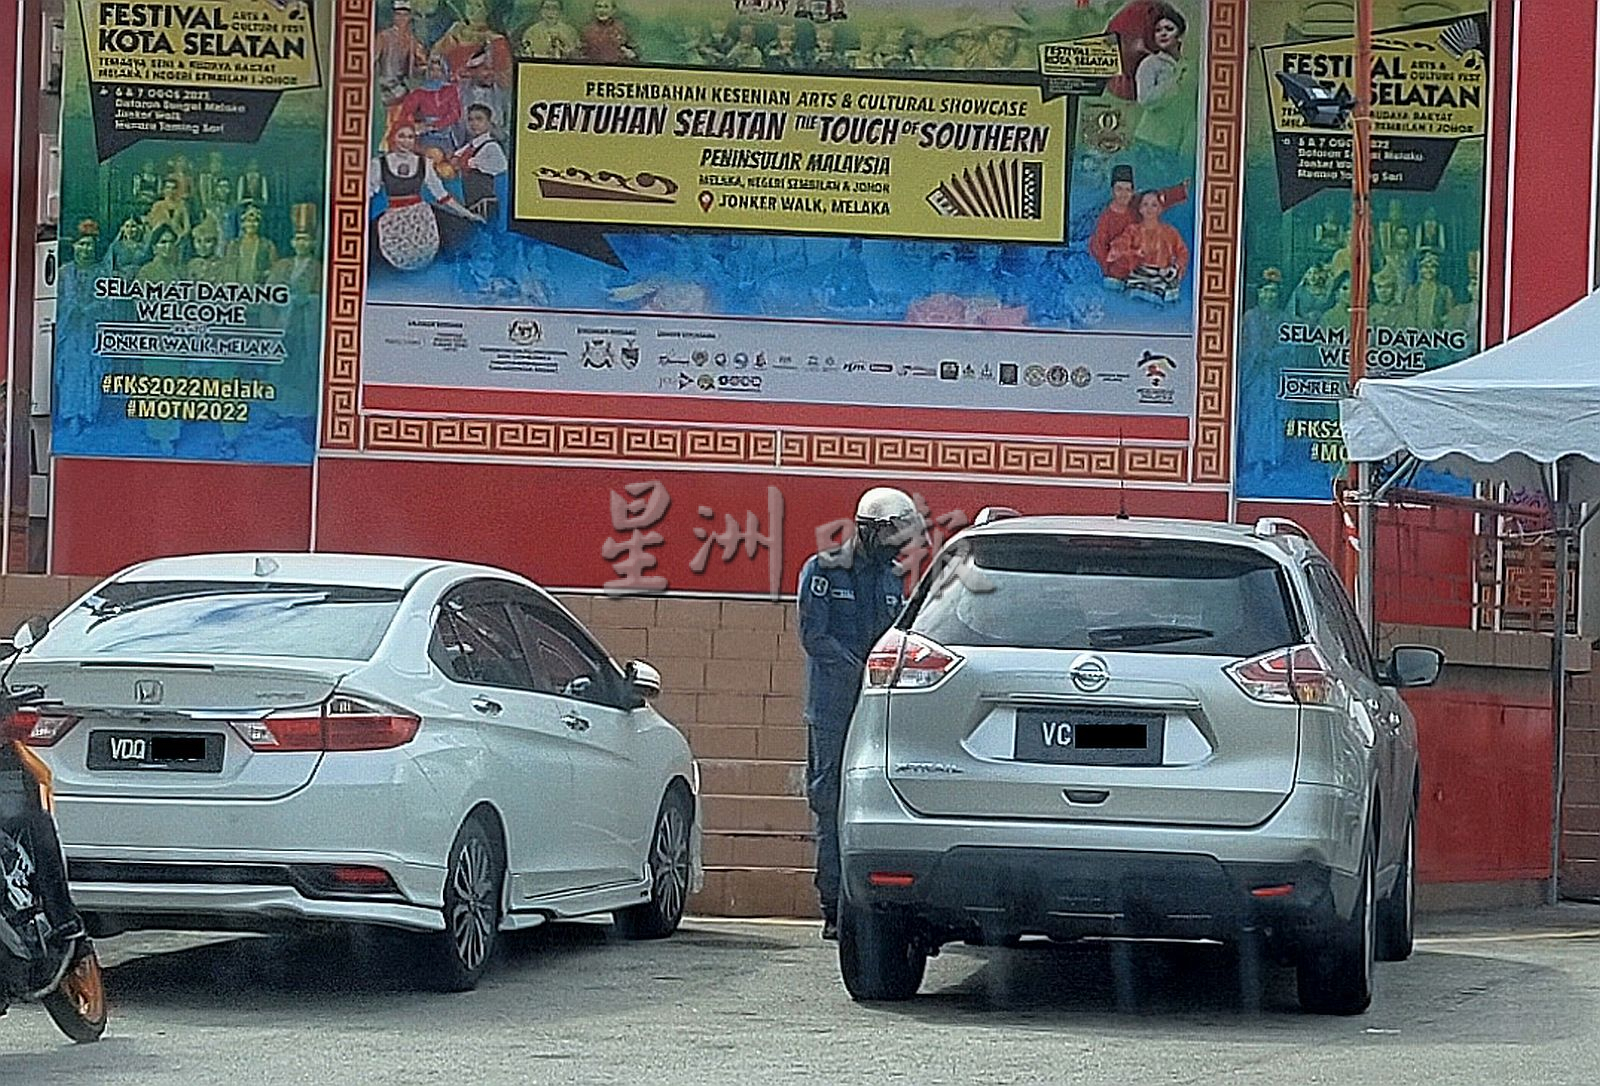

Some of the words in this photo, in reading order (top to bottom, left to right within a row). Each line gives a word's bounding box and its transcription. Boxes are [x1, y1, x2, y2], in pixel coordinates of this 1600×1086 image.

[100, 3, 229, 30] FESTIVAL
[231, 22, 278, 32] CULTURE
[282, 23, 304, 33] FEST
[232, 12, 257, 21] ARTS
[100, 29, 174, 54] KOTA
[184, 33, 304, 59] SELATAN
[1283, 53, 1406, 80] FESTIAL
[1410, 70, 1454, 81] CULTURE
[1458, 72, 1480, 82] FEST
[1411, 61, 1435, 70] ARTS
[586, 81, 706, 101] PERSEMBAHAN
[711, 87, 791, 105] KESENIAN
[797, 91, 837, 108] ARTS
[842, 92, 852, 109] &
[858, 94, 935, 113] CULTURAL
[940, 98, 1028, 117] SHOWCASE
[528, 102, 668, 135] SENTUHAN
[673, 107, 787, 140] SELATAN
[795, 114, 818, 130] THE
[820, 116, 899, 144] TOUCH
[901, 121, 920, 135] OF
[918, 122, 1049, 153] SOUTHERN
[700, 148, 803, 171] PENINSULAR
[806, 153, 890, 175] MALAYSIA
[719, 194, 777, 211] JONKER
[781, 196, 827, 214] WALK,
[832, 199, 890, 215] MELAKA
[95, 278, 191, 300] SELAMAT
[199, 283, 289, 305] DATANG
[138, 302, 246, 324] WELCOME
[94, 331, 159, 356] JONKER
[219, 339, 287, 358] MELAKA
[1379, 328, 1466, 350] DATANG
[1320, 348, 1425, 369] WECOME
[102, 375, 276, 400] #FKS2022Melaka
[1277, 375, 1341, 399] JONKER
[126, 400, 248, 422] #MOTN2022
